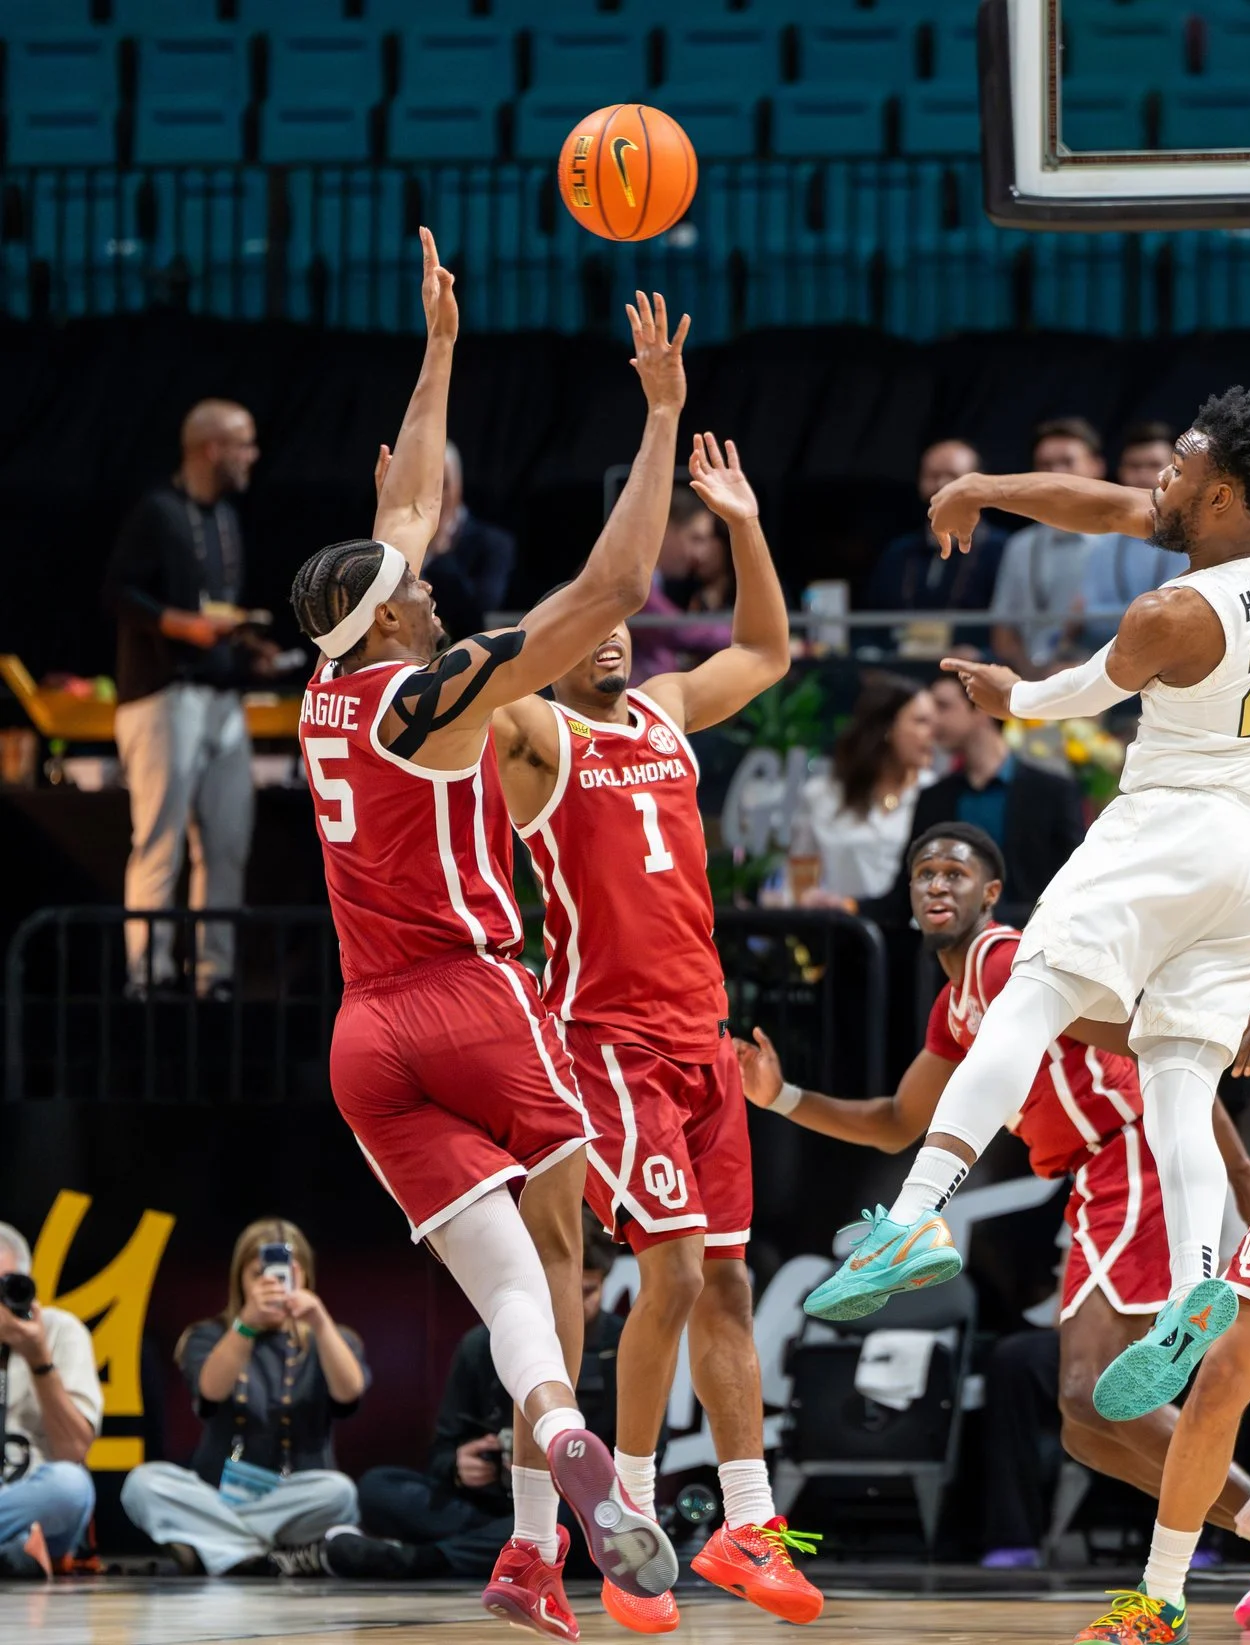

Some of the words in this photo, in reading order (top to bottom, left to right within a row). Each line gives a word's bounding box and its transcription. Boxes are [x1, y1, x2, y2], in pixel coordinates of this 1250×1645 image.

[570, 135, 594, 207] ELITE
[304, 737, 357, 843] 5
[579, 758, 688, 790] OKLAHOMA
[631, 792, 675, 874] 1
[641, 1154, 689, 1210] OU
